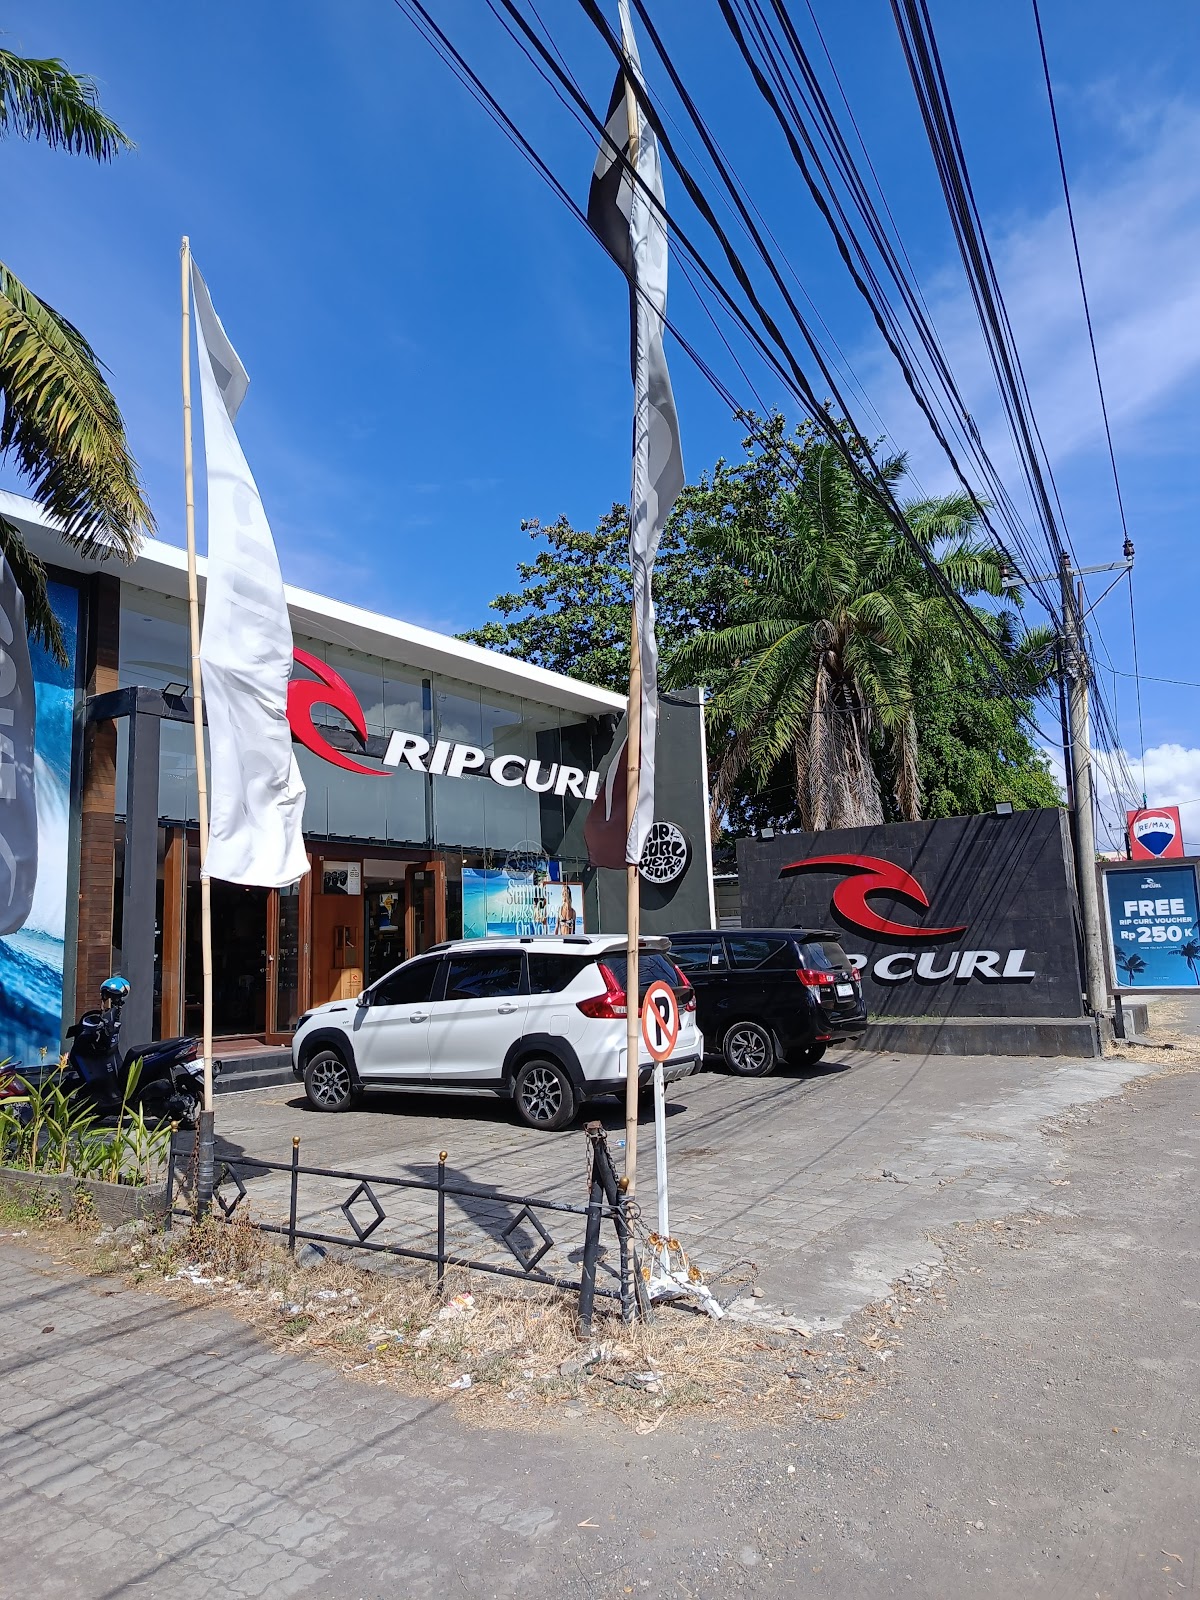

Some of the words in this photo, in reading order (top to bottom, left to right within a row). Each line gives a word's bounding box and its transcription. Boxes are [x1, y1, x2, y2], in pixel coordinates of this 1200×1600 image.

[382, 730, 485, 778] RIP
[489, 754, 600, 801] CURL
[1138, 821, 1171, 832] RE/MAX
[1123, 898, 1185, 917] FREE
[1154, 916, 1192, 924] VOUCHER
[1120, 931, 1136, 940] Rp
[1136, 925, 1182, 943] 250
[1184, 928, 1193, 937] K
[873, 949, 1036, 980] CURL
[654, 996, 670, 1046] P
